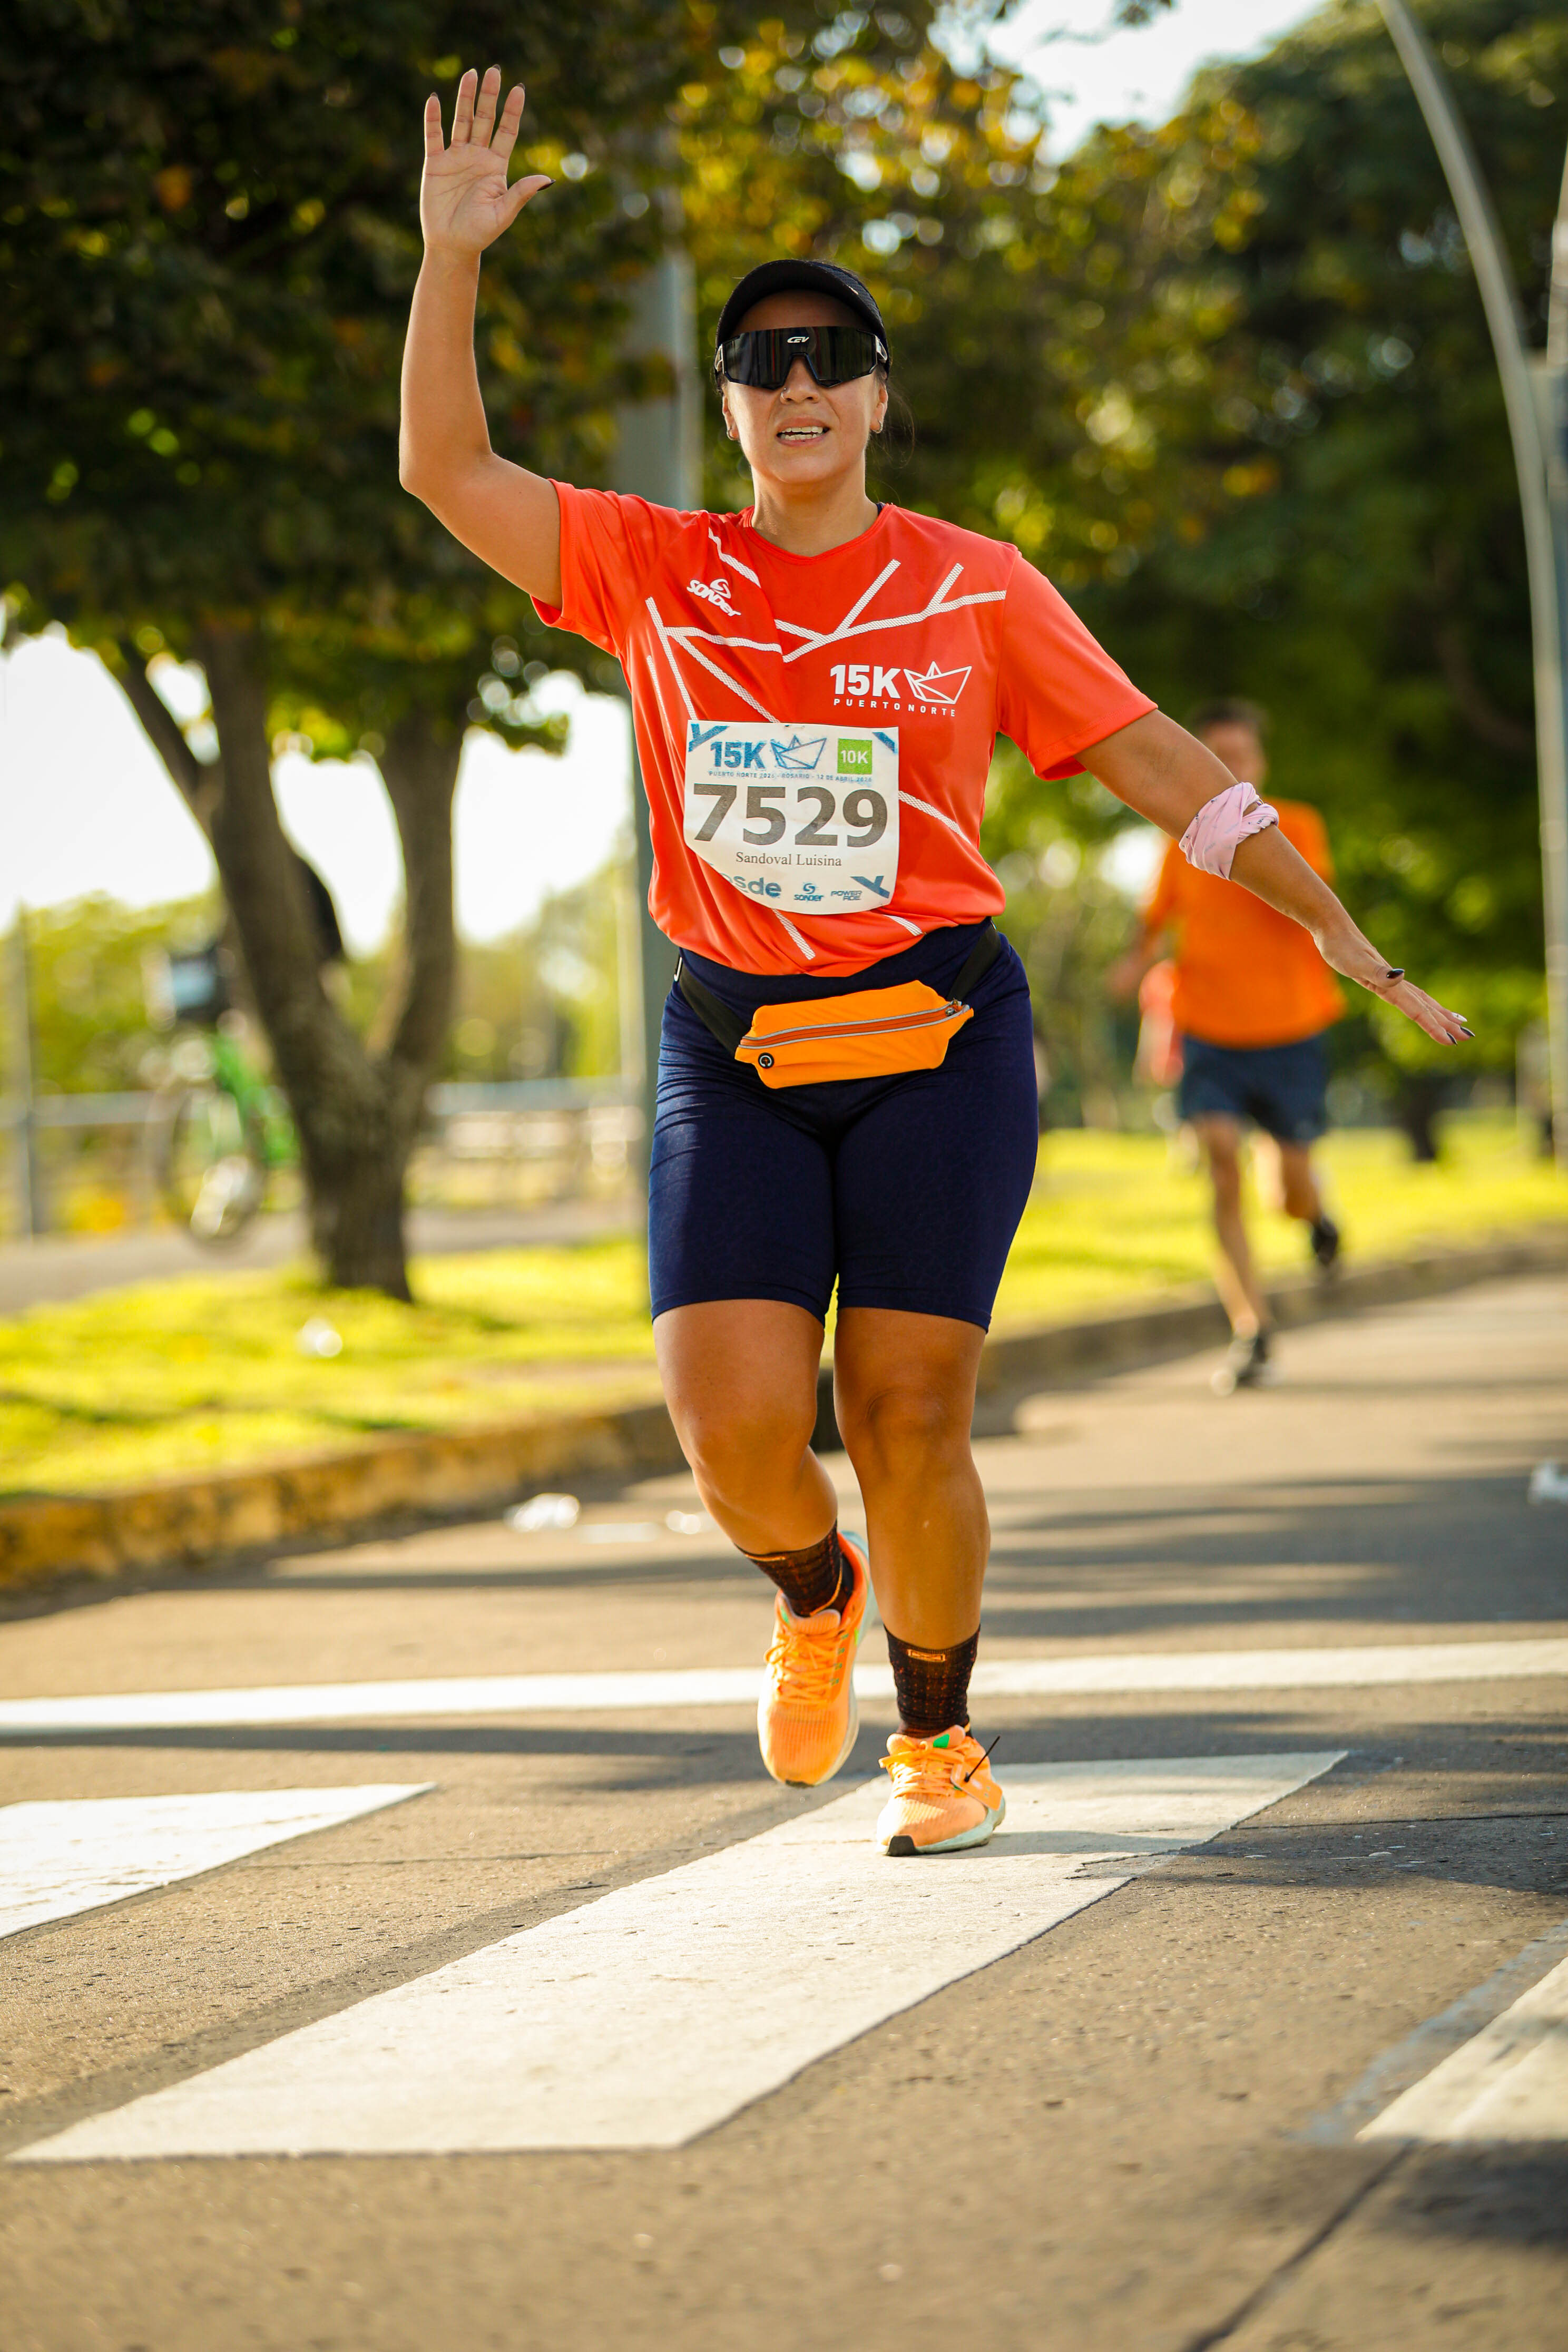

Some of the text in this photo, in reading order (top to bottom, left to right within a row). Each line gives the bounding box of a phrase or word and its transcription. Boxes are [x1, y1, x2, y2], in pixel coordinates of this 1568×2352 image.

[830, 664, 901, 699] 15K
[834, 698, 955, 717] PUERTO NORTE
[710, 741, 767, 769] 15K
[840, 750, 868, 764] 10K
[694, 783, 888, 848] 7529
[736, 851, 842, 866] Sandoval Luisina
